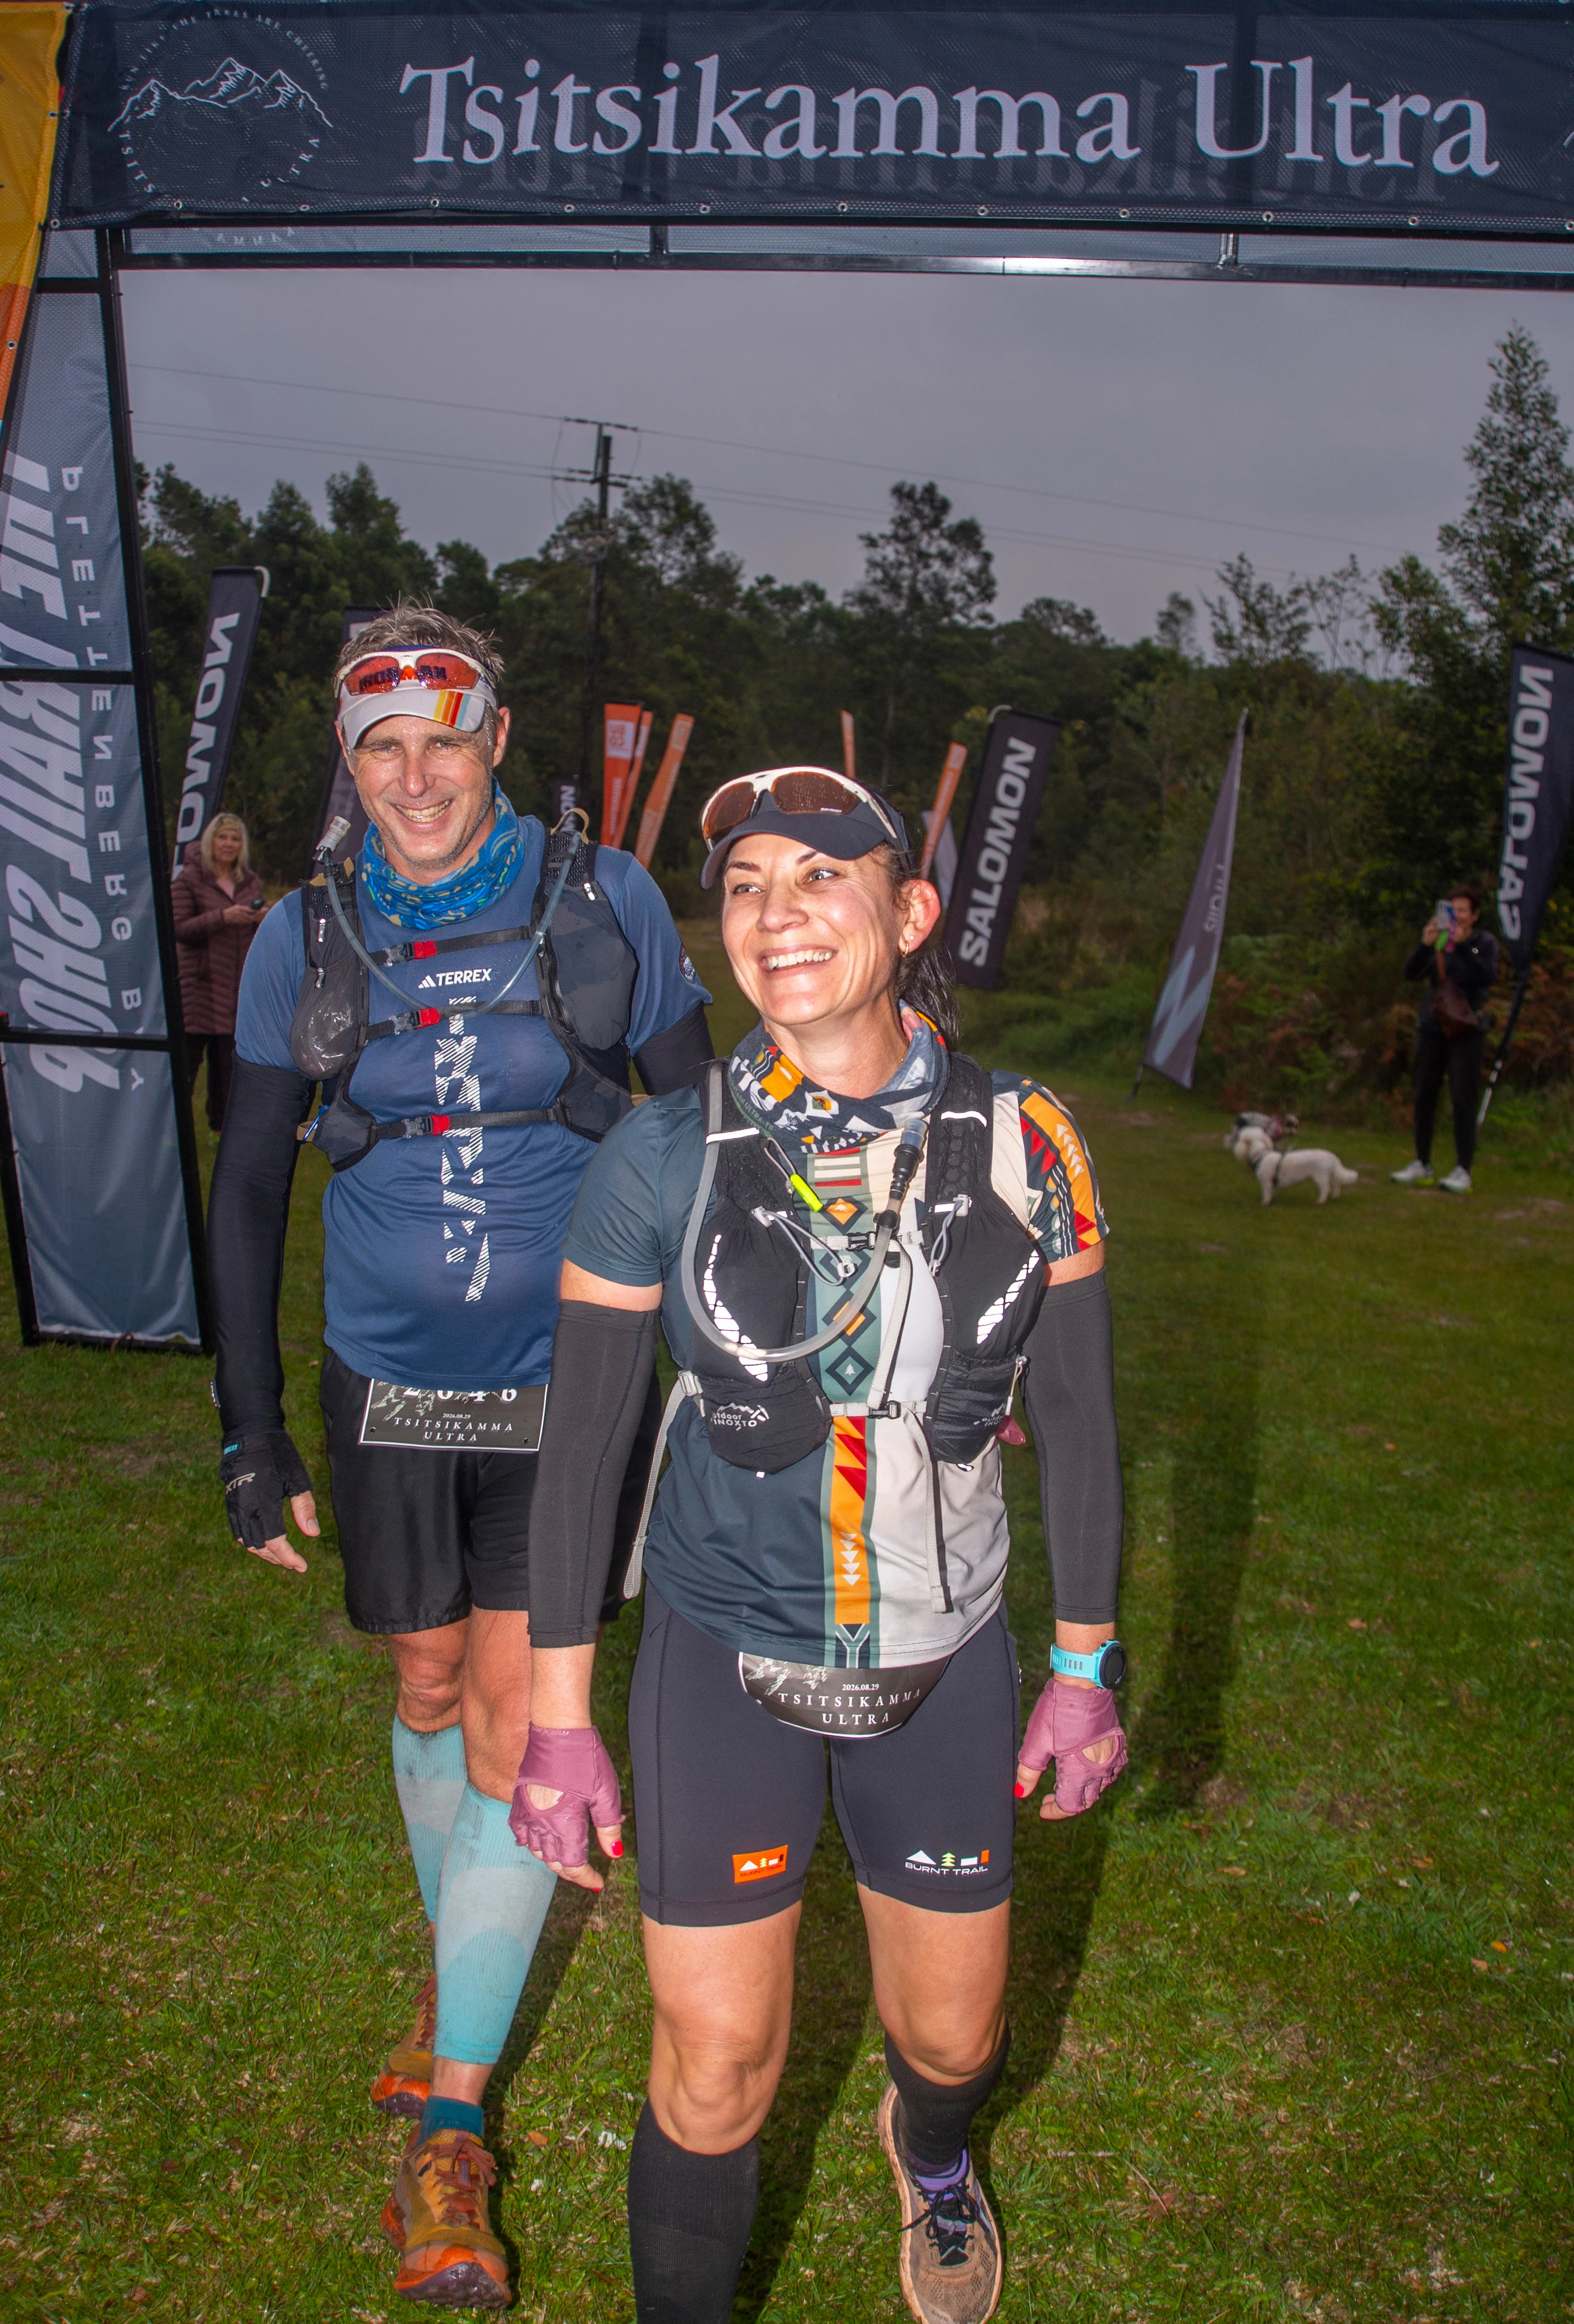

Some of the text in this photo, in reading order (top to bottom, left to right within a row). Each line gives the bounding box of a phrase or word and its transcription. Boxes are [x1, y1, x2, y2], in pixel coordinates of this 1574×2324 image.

[255, 14, 281, 29] ARE
[285, 30, 328, 90] CHEERING
[399, 54, 1500, 177] Tsitsikamma Ultra
[958, 736, 1037, 968] SALOMON
[436, 969, 492, 986] TERREX
[394, 1417, 513, 1431] TSITSIKAMMA
[425, 1432, 477, 1441] ULTRA
[778, 1688, 920, 1708] TSITSIKAMMA
[822, 1713, 889, 1726] ULTRA
[905, 1862, 988, 1875] BURNT TRAIL
